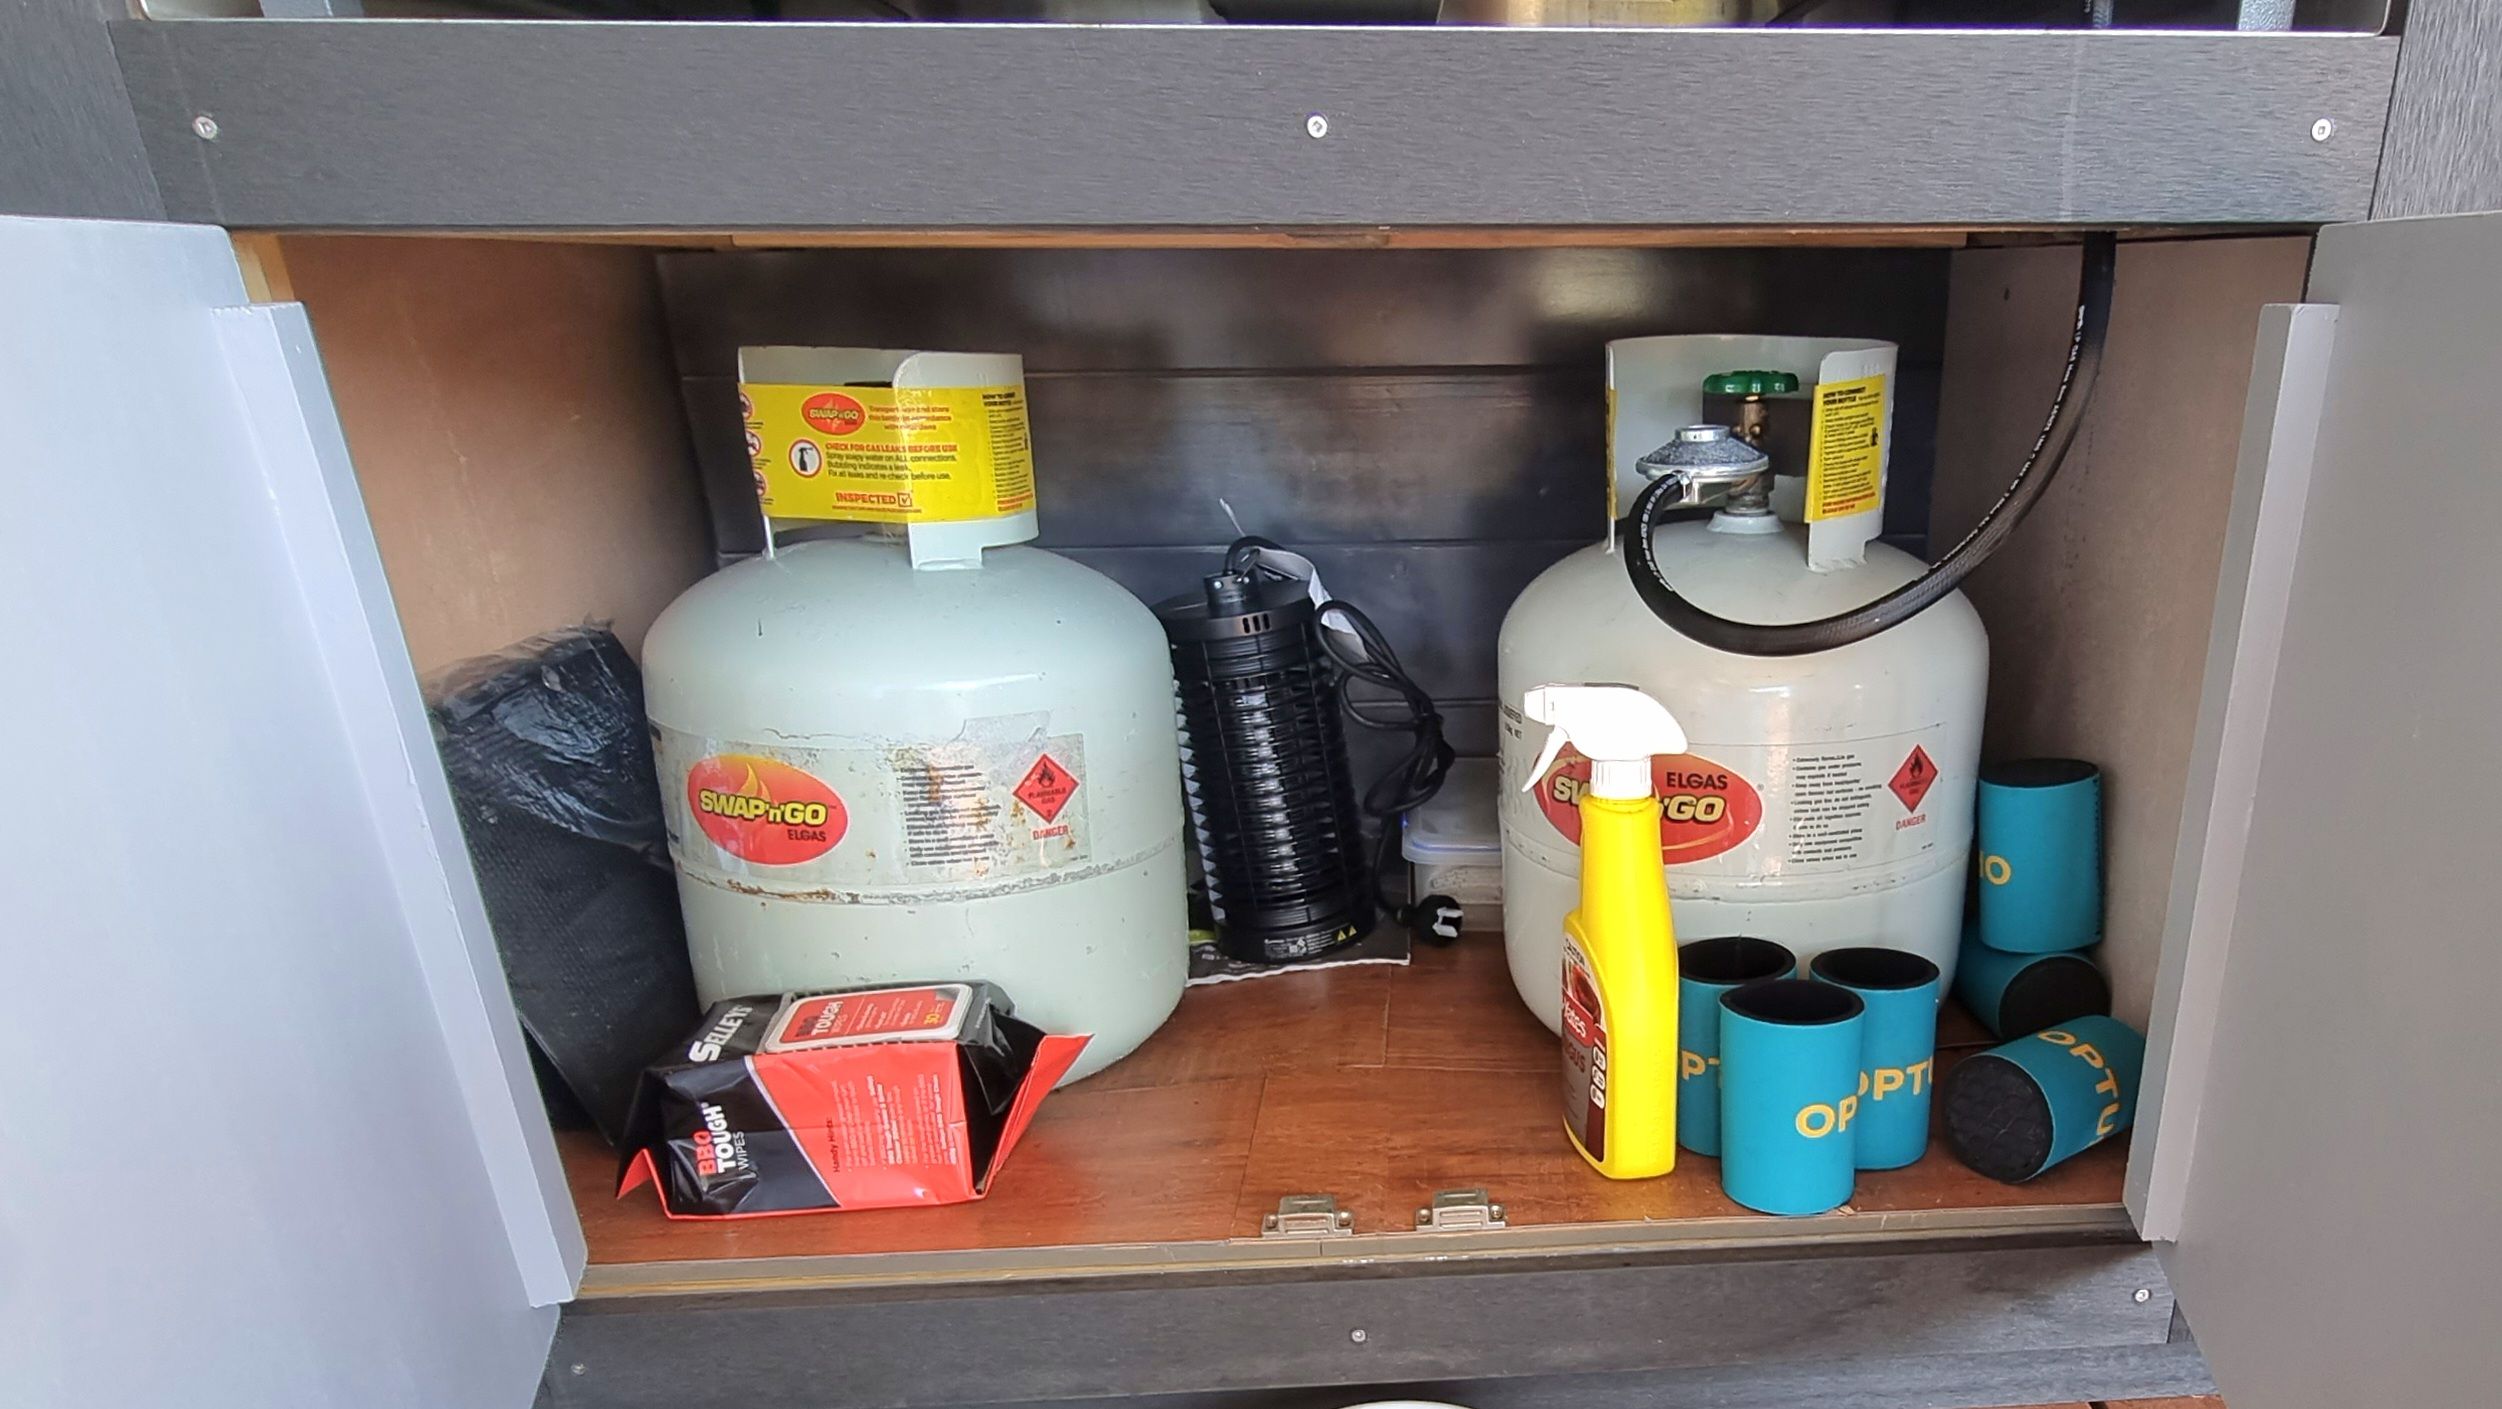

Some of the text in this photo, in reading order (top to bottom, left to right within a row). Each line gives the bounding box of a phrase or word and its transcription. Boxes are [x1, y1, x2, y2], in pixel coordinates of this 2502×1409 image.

[836, 492, 896, 504] INSPECTED
[1666, 771, 1728, 790] ELGAS
[1032, 825, 1069, 840] DANGER
[1895, 814, 1926, 830] DANGER
[787, 829, 827, 842] ELGAS
[812, 1000, 844, 1036] TOUGH
[687, 1004, 755, 1063] SELLEYS
[702, 1105, 735, 1174] TOUGH
[732, 1131, 750, 1171] WIPES
[830, 1144, 841, 1173] Handy
